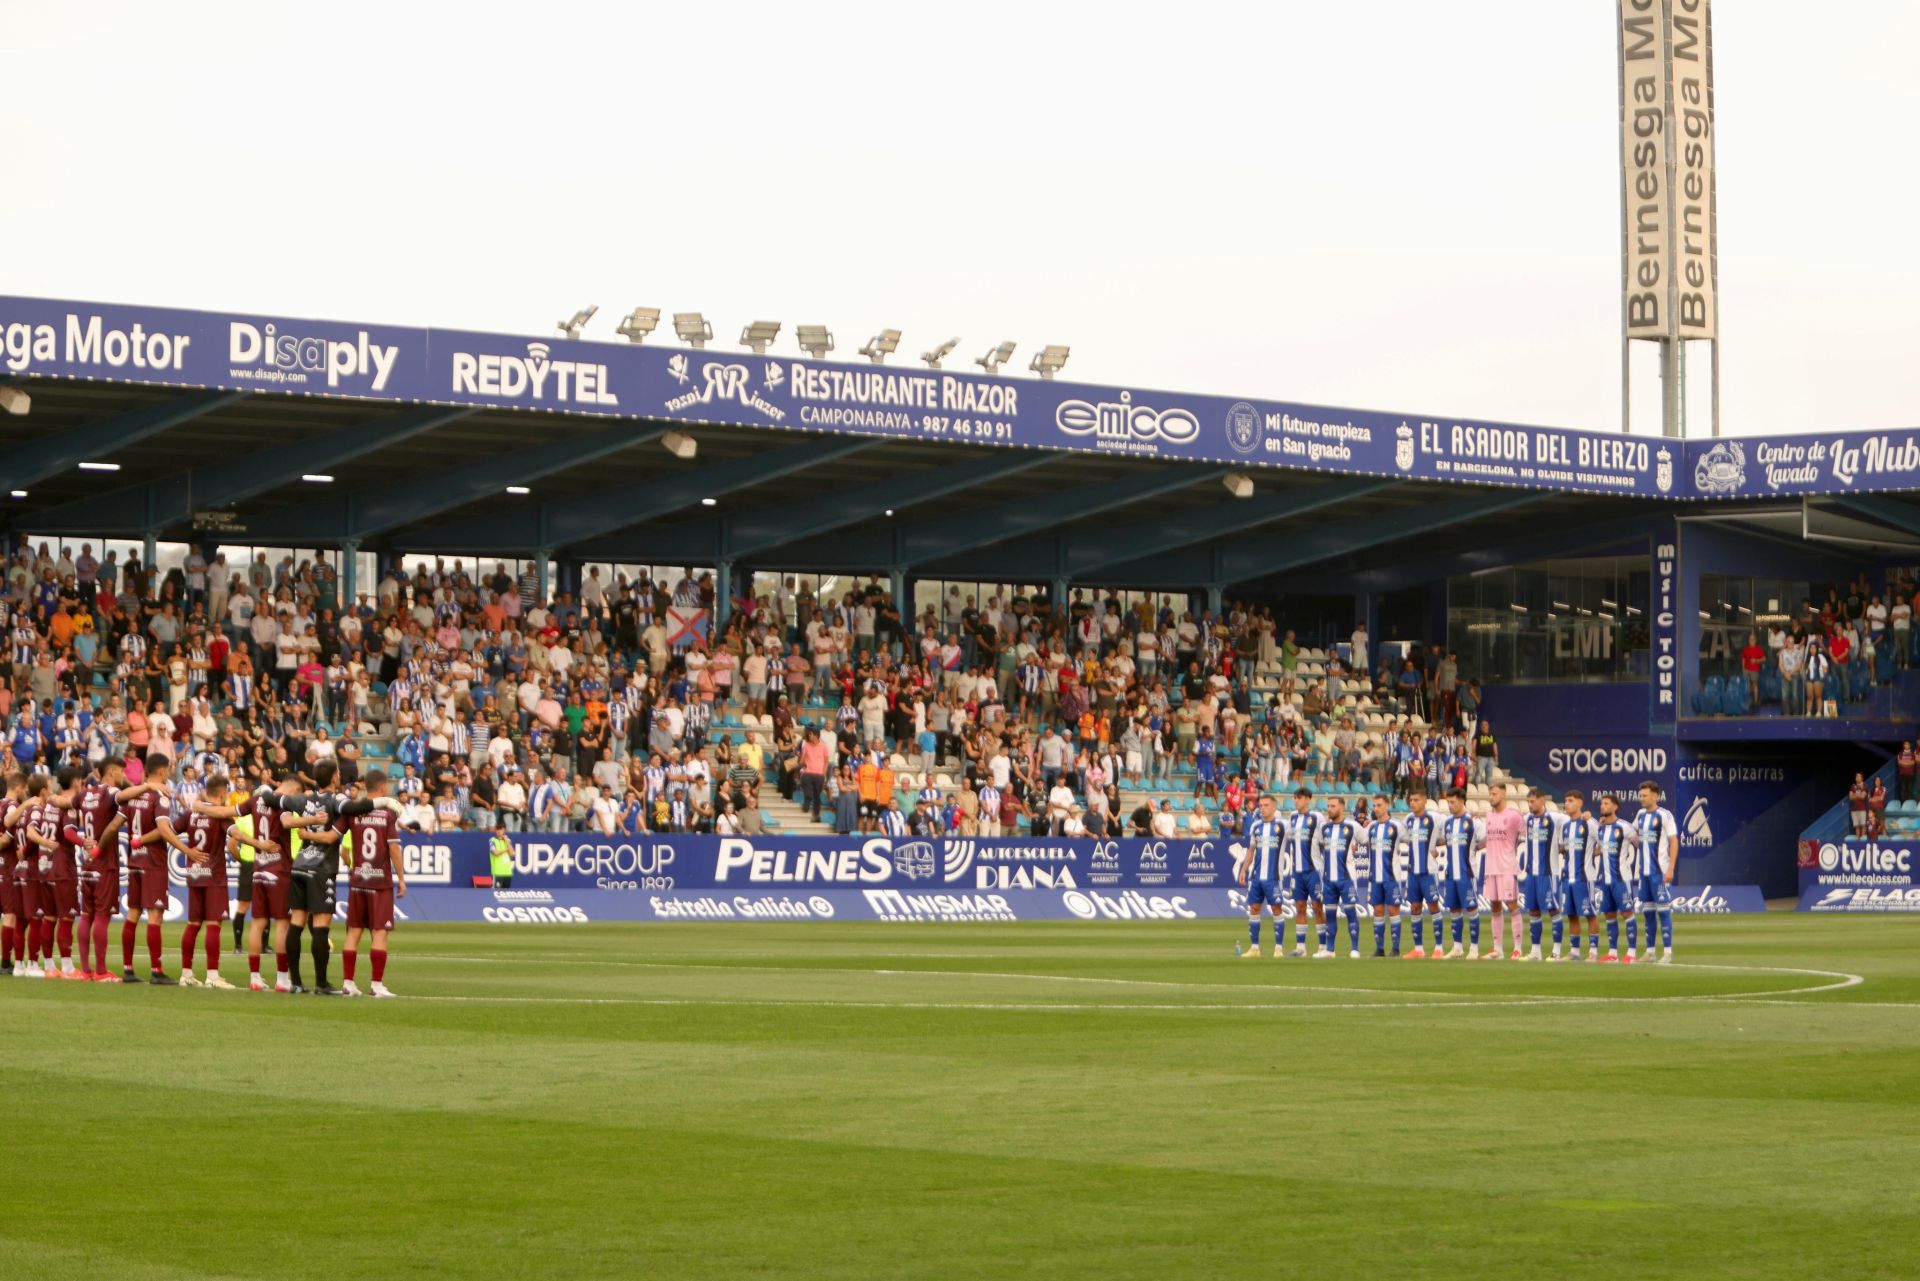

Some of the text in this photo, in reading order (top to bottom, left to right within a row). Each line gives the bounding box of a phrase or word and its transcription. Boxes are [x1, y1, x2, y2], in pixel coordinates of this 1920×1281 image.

[1628, 75, 1662, 328] Bernesga
[1680, 77, 1709, 328] Bernesga
[0, 314, 190, 371] ga Motor
[229, 321, 399, 391] Disaply
[229, 368, 306, 384] www.disaply.com
[452, 352, 619, 404] REDYTEL
[790, 362, 1018, 416] RESTAURANTE RIAZOR
[800, 405, 1012, 439] CAMPONARAYA 987 46 30 91
[1056, 391, 1200, 443] emico
[1265, 414, 1371, 442] Mi futuro empieza
[1265, 437, 1351, 462] en San Ignacio
[1420, 423, 1649, 473] EL ASADOR DEL BIERZO
[1757, 441, 1826, 463] Centro de
[1830, 436, 1920, 485] La Nub
[1436, 460, 1450, 471] EN
[1521, 468, 1534, 479] NO
[1537, 469, 1574, 482] OLVIDE
[1576, 472, 1635, 487] VISITARNOS
[1765, 463, 1819, 490] Lavado
[1657, 544, 1675, 704] MUSIC TOUR
[1679, 765, 1784, 783] cufica pizarras
[85, 811, 95, 841] 6
[258, 815, 270, 842] 9
[362, 827, 377, 859] 8
[977, 848, 1077, 859] AUTOESCUELA
[1092, 841, 1118, 860] AC
[1140, 842, 1166, 861] AC
[1681, 834, 1713, 847] cufica
[402, 844, 451, 873] CER
[1842, 843, 1911, 871] tvitec
[976, 865, 1078, 889] DIANA
[494, 890, 551, 900] cementos
[650, 896, 812, 917] Estrella Galicia
[482, 906, 588, 923] cosmos
